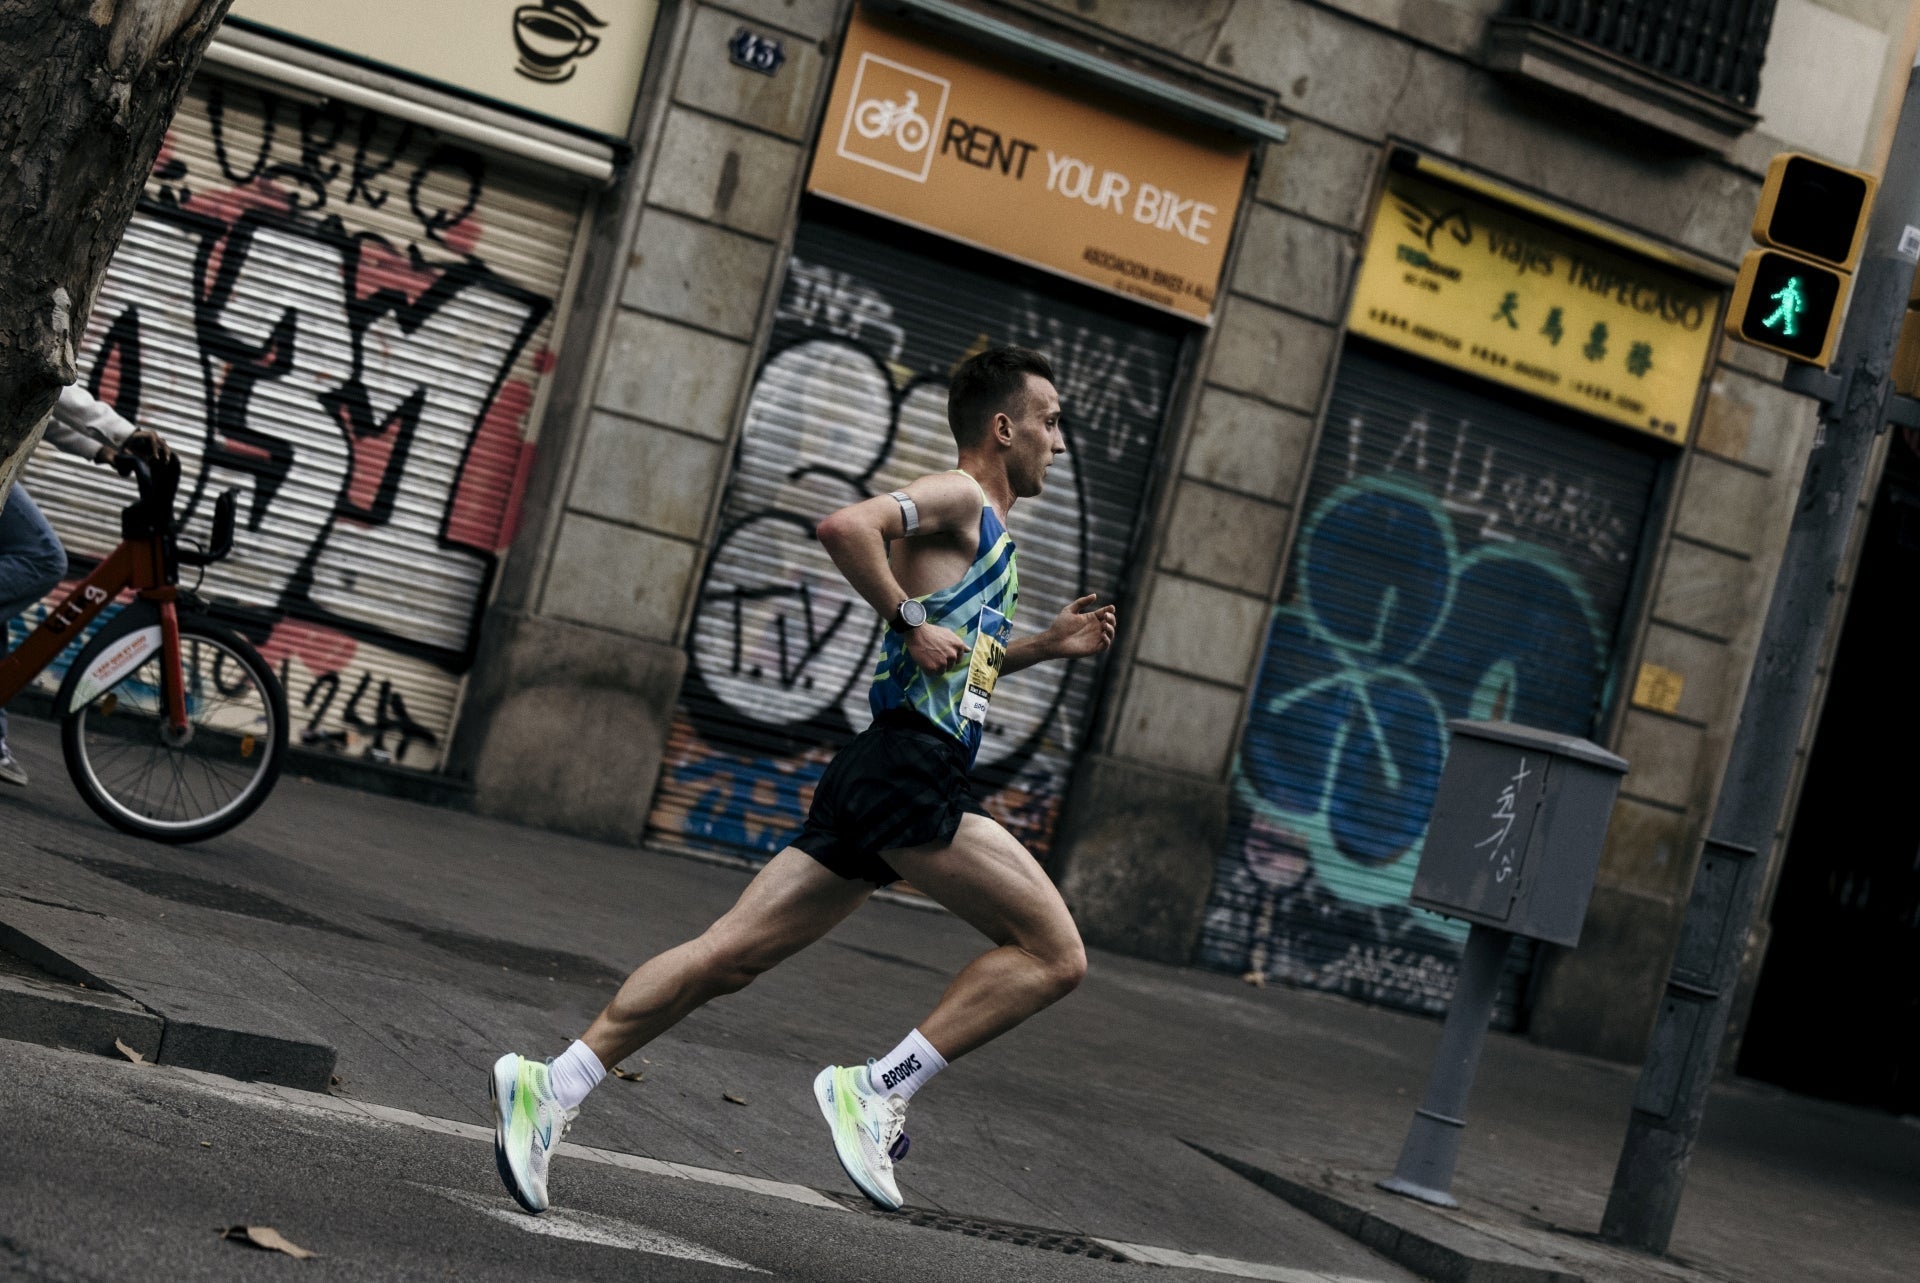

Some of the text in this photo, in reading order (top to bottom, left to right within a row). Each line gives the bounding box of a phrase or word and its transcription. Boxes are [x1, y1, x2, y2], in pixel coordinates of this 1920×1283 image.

[941, 117, 1218, 245] RENT YOUR BIKE
[881, 1053, 923, 1090] BROOKS
